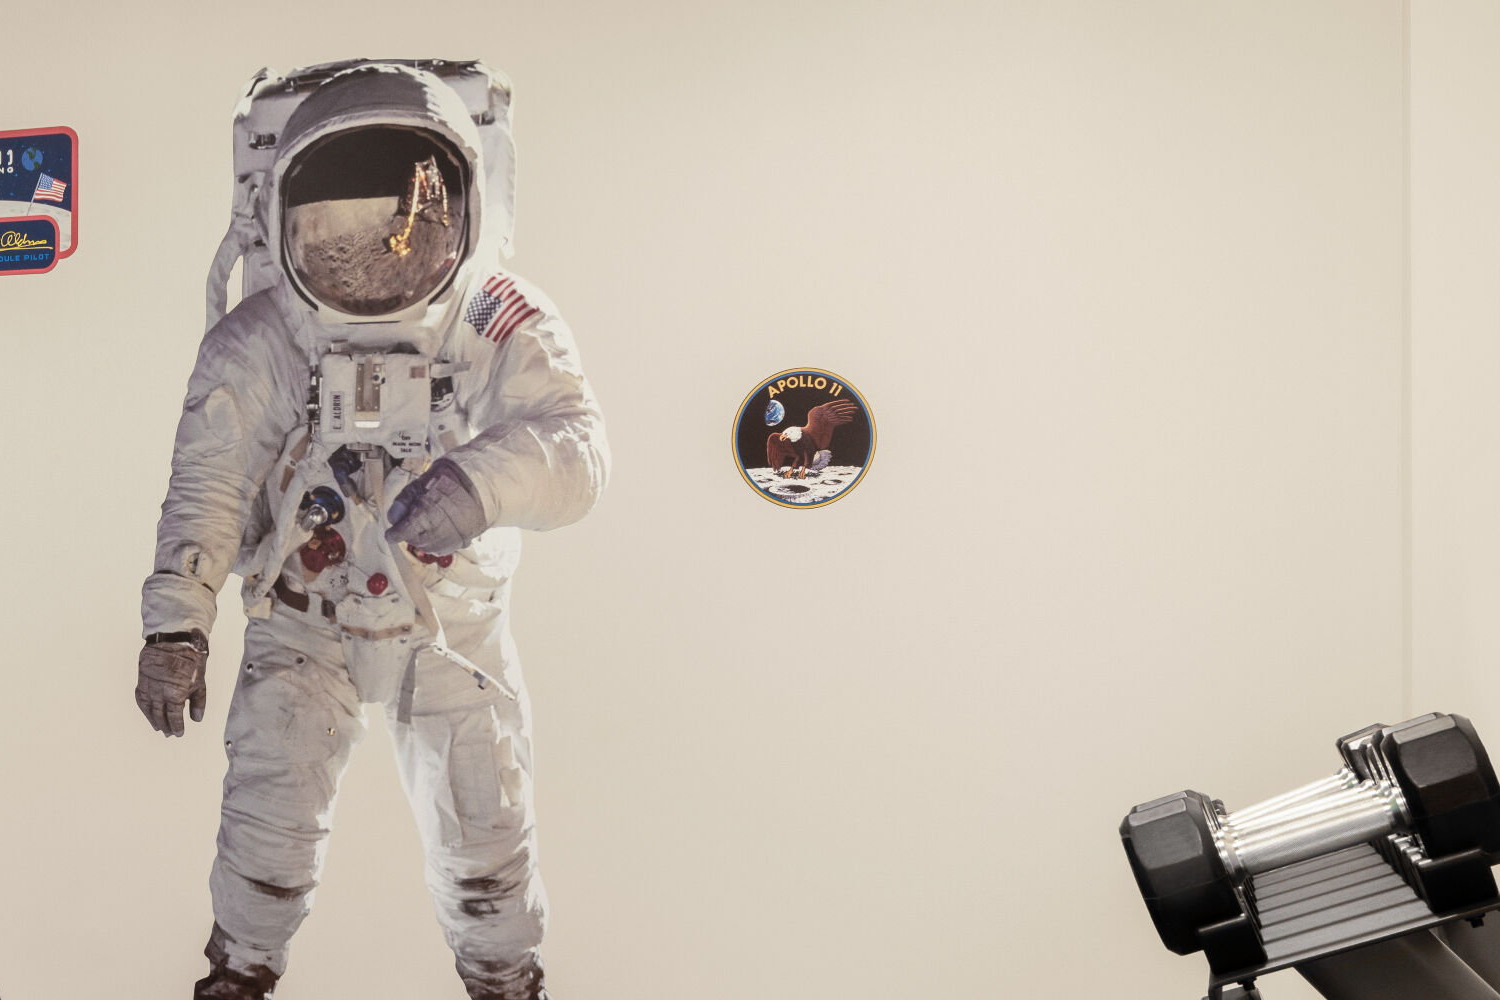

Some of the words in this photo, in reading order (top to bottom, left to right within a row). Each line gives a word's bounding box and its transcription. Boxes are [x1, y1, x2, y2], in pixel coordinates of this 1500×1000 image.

[23, 253, 50, 261] PILOT
[767, 375, 827, 399] APOLLO
[829, 382, 843, 397] 11
